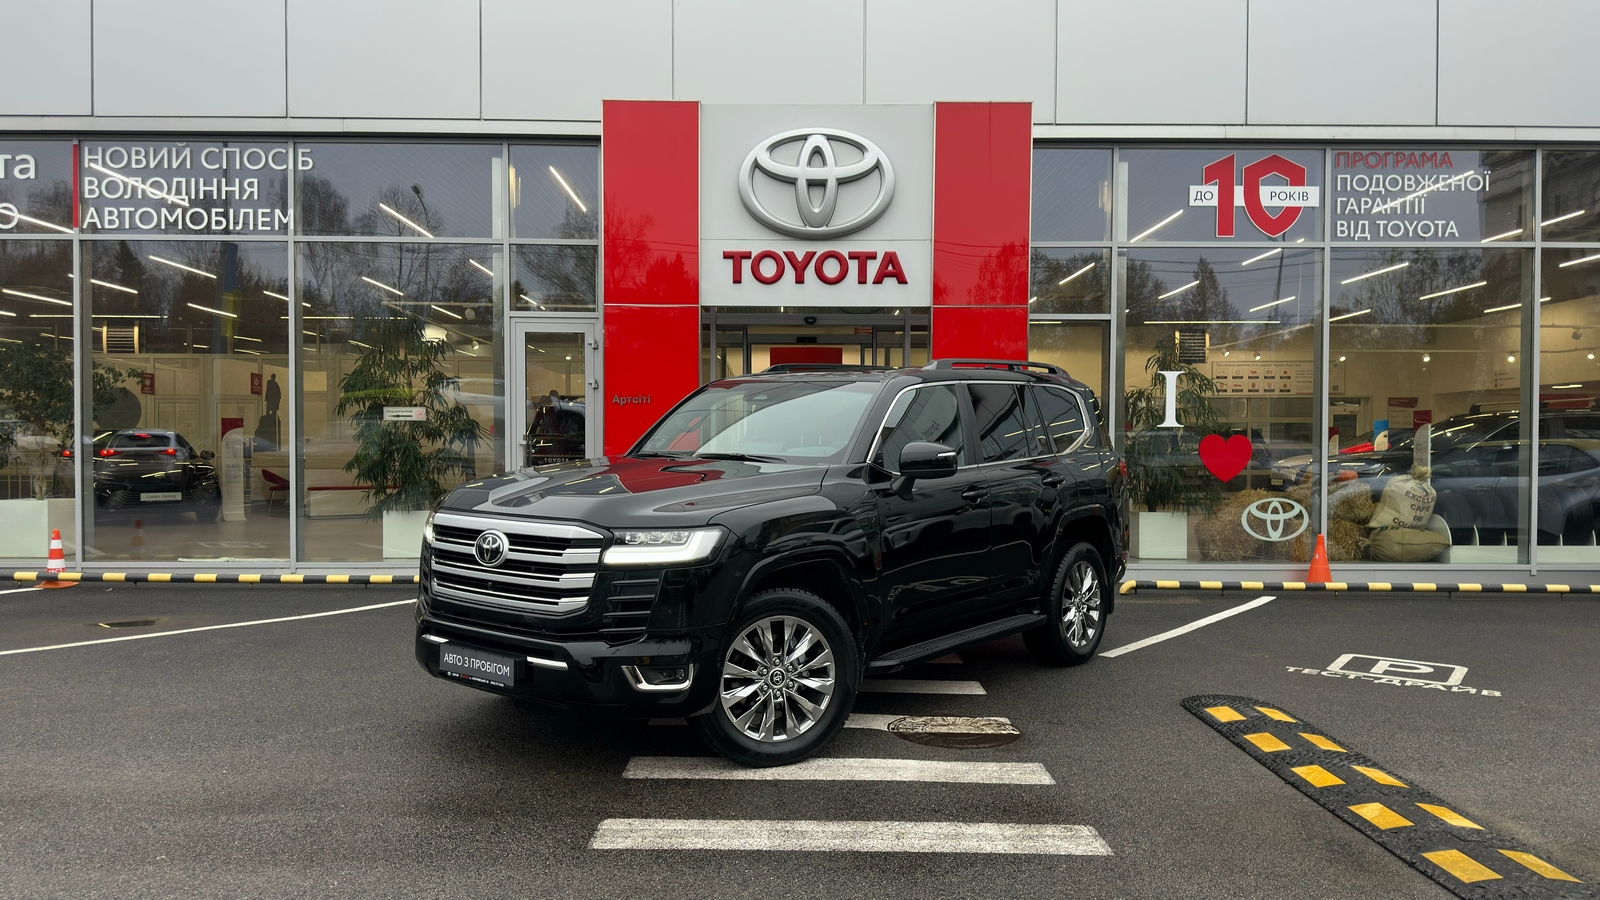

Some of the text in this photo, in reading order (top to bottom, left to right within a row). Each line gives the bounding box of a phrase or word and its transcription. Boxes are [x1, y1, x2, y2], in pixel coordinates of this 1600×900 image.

[84, 142, 314, 170] НОВИЙ СПОСІБ
[1335, 151, 1453, 169] ПРОГРАМА
[84, 177, 258, 205] ВОЛОДІННЯ
[1336, 171, 1491, 194] ПОДОВЖЕНОЇ
[1193, 153, 1309, 238] ДО 10 РОКІВ
[1336, 194, 1425, 215] ГАРАНТІЇ
[82, 207, 294, 230] АВТОМОБІЛЕМ
[1336, 220, 1459, 241] ВІД TOYOTA
[723, 250, 908, 285] TOYOTA
[612, 394, 651, 406] Артсіті
[1156, 370, 1185, 427] I
[443, 653, 463, 666] АВТО
[470, 658, 510, 677] ПРОБІГОМ
[1285, 666, 1502, 697] ТЕСТ-ДРАЙВ
